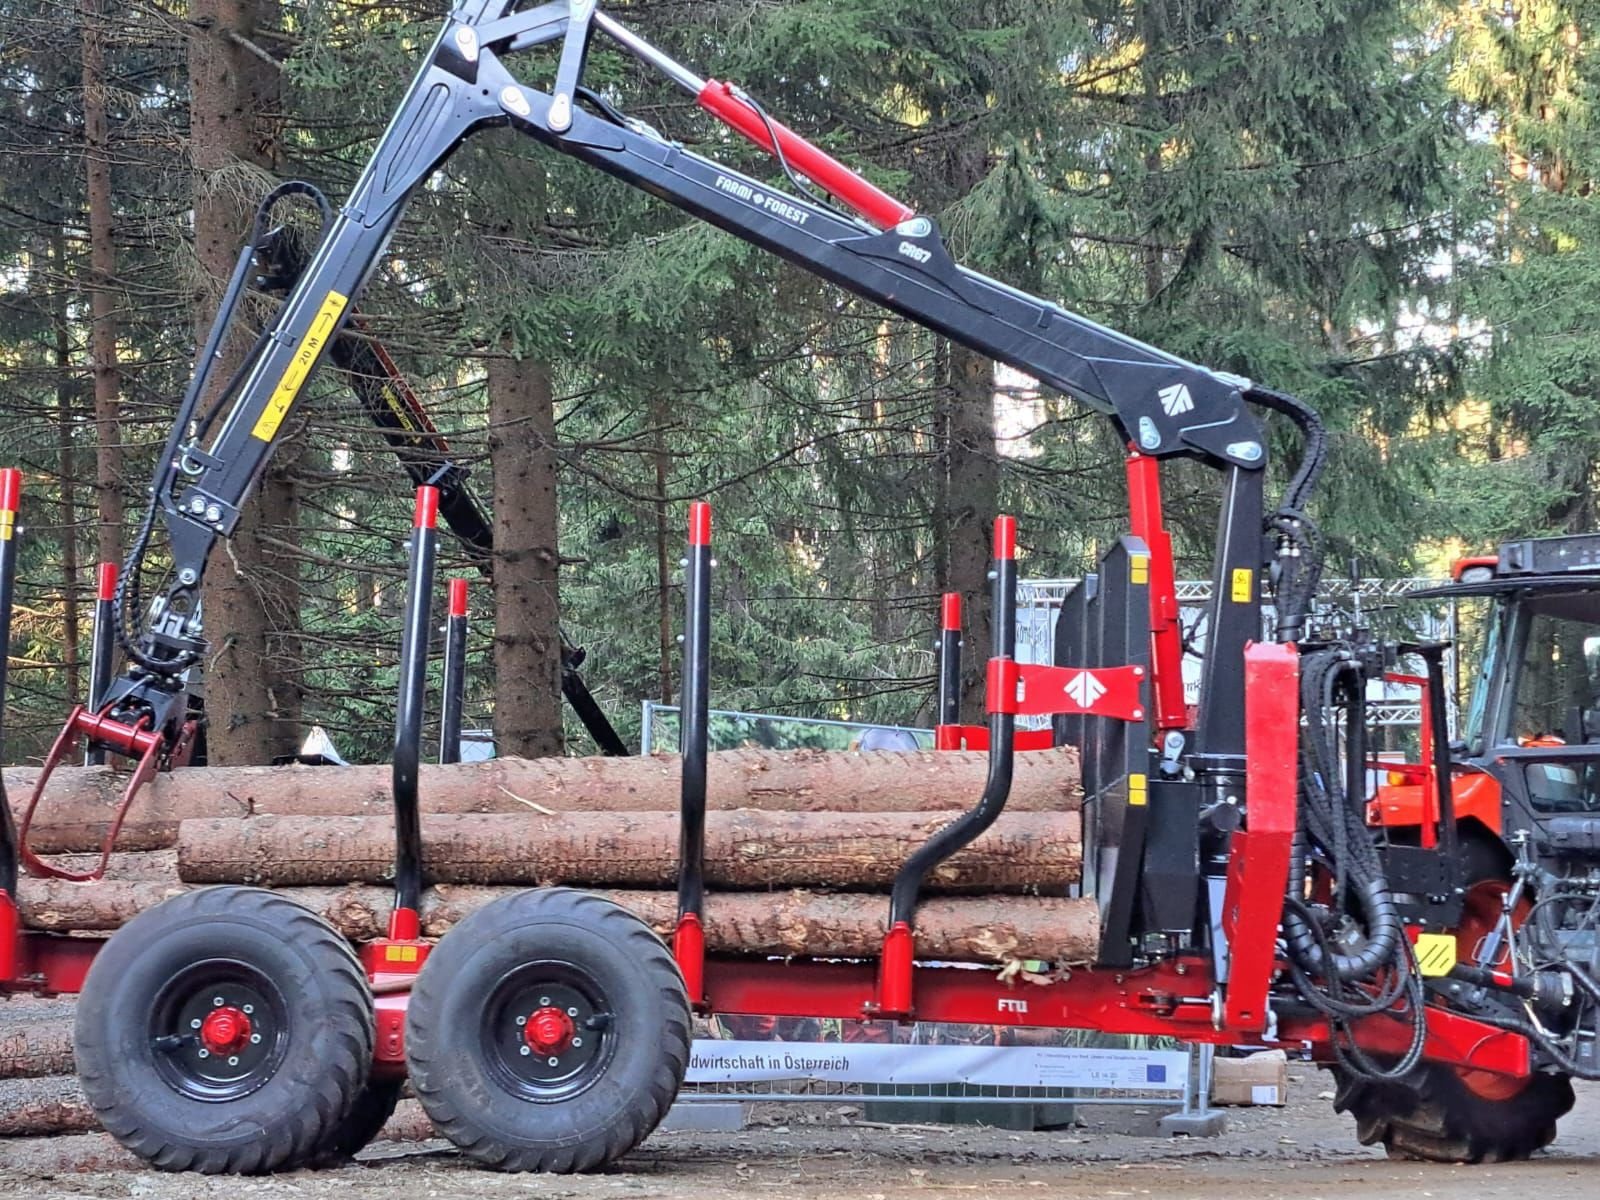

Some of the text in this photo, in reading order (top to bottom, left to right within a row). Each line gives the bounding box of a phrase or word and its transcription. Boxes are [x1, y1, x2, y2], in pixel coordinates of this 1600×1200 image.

[715, 175, 809, 224] FARMI FOREST
[298, 337, 319, 365] 20 M
[687, 1052, 850, 1071] dwirtschaft in Österreich
